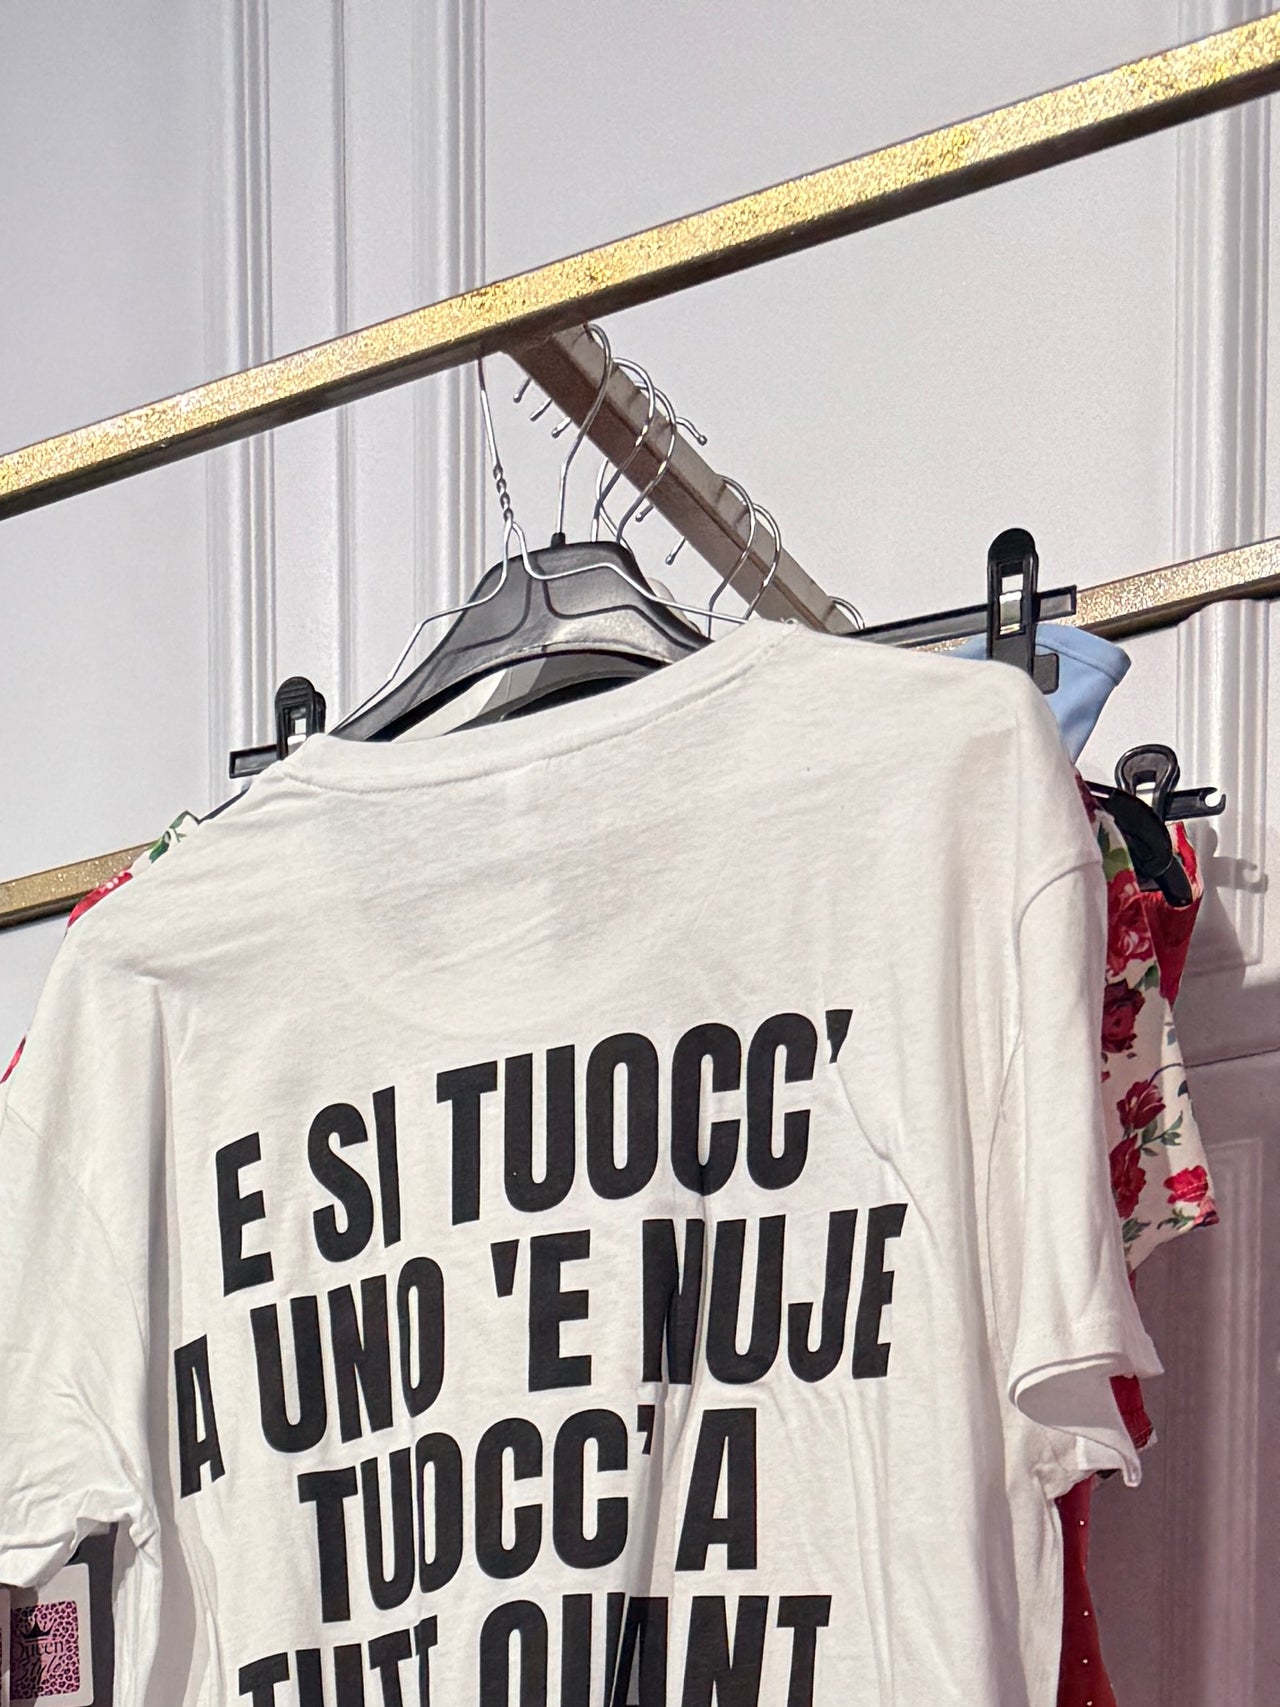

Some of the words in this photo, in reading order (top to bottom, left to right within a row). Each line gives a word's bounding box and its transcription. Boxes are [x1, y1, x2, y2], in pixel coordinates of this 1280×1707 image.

[215, 1132, 274, 1297] E
[307, 1086, 400, 1262] SI
[436, 1009, 853, 1225] TUOCC'
[173, 1334, 225, 1498] A
[250, 1256, 444, 1453] UNO
[490, 1229, 592, 1392] 'E
[642, 1203, 908, 1384] NUJE
[297, 1405, 655, 1623] TUOCC'
[675, 1407, 757, 1571] A
